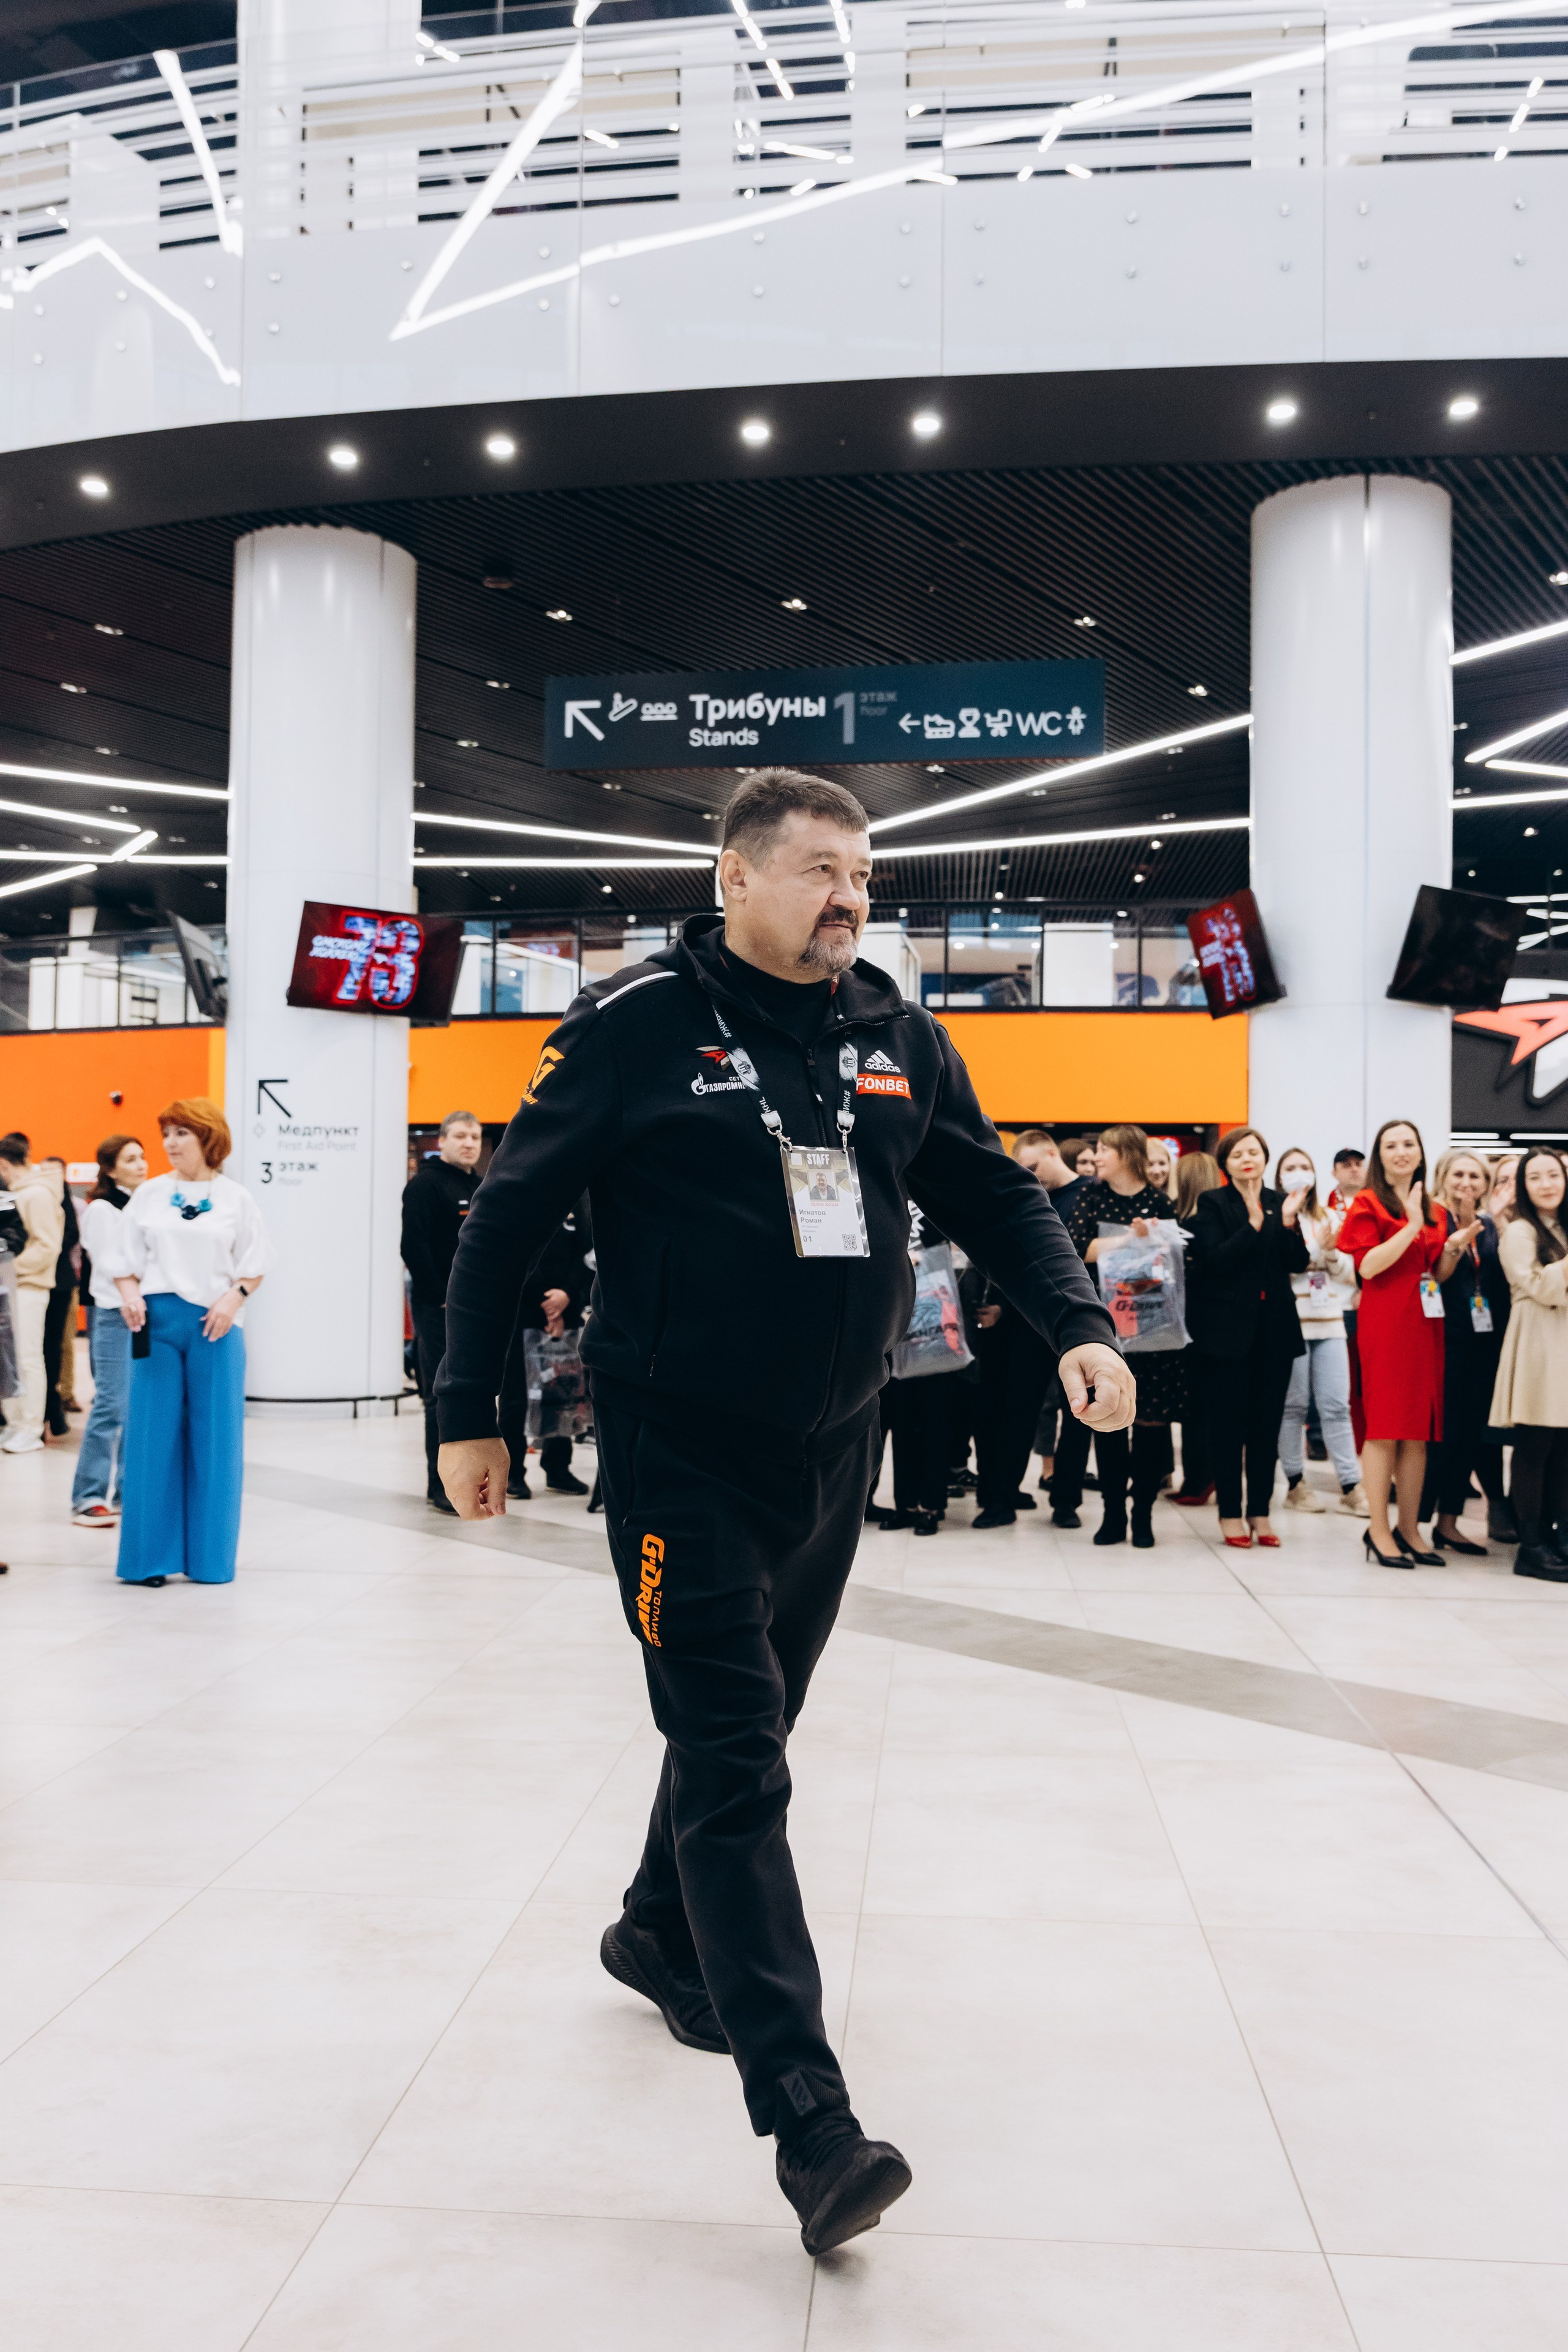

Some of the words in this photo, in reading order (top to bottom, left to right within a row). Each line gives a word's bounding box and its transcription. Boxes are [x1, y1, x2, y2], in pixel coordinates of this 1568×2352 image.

[689, 692, 826, 725] Трибуны
[834, 692, 855, 745] 1
[1016, 712, 1062, 736] WC
[688, 726, 760, 747] Stands
[865, 1062, 902, 1073] adidas
[704, 1081, 746, 1093] ГАЗПРОМН
[856, 1077, 910, 1095] FONBET
[759, 1096, 771, 1114] KHL
[278, 1124, 360, 1139] Медпункт
[277, 1140, 302, 1150] First
[306, 1141, 324, 1151] Aid
[327, 1141, 356, 1152] Point
[807, 1153, 829, 1165] STAFF
[261, 1162, 273, 1183] 3
[279, 1162, 318, 1171] этаж
[651, 1591, 662, 1648] ТОПЛИВО
